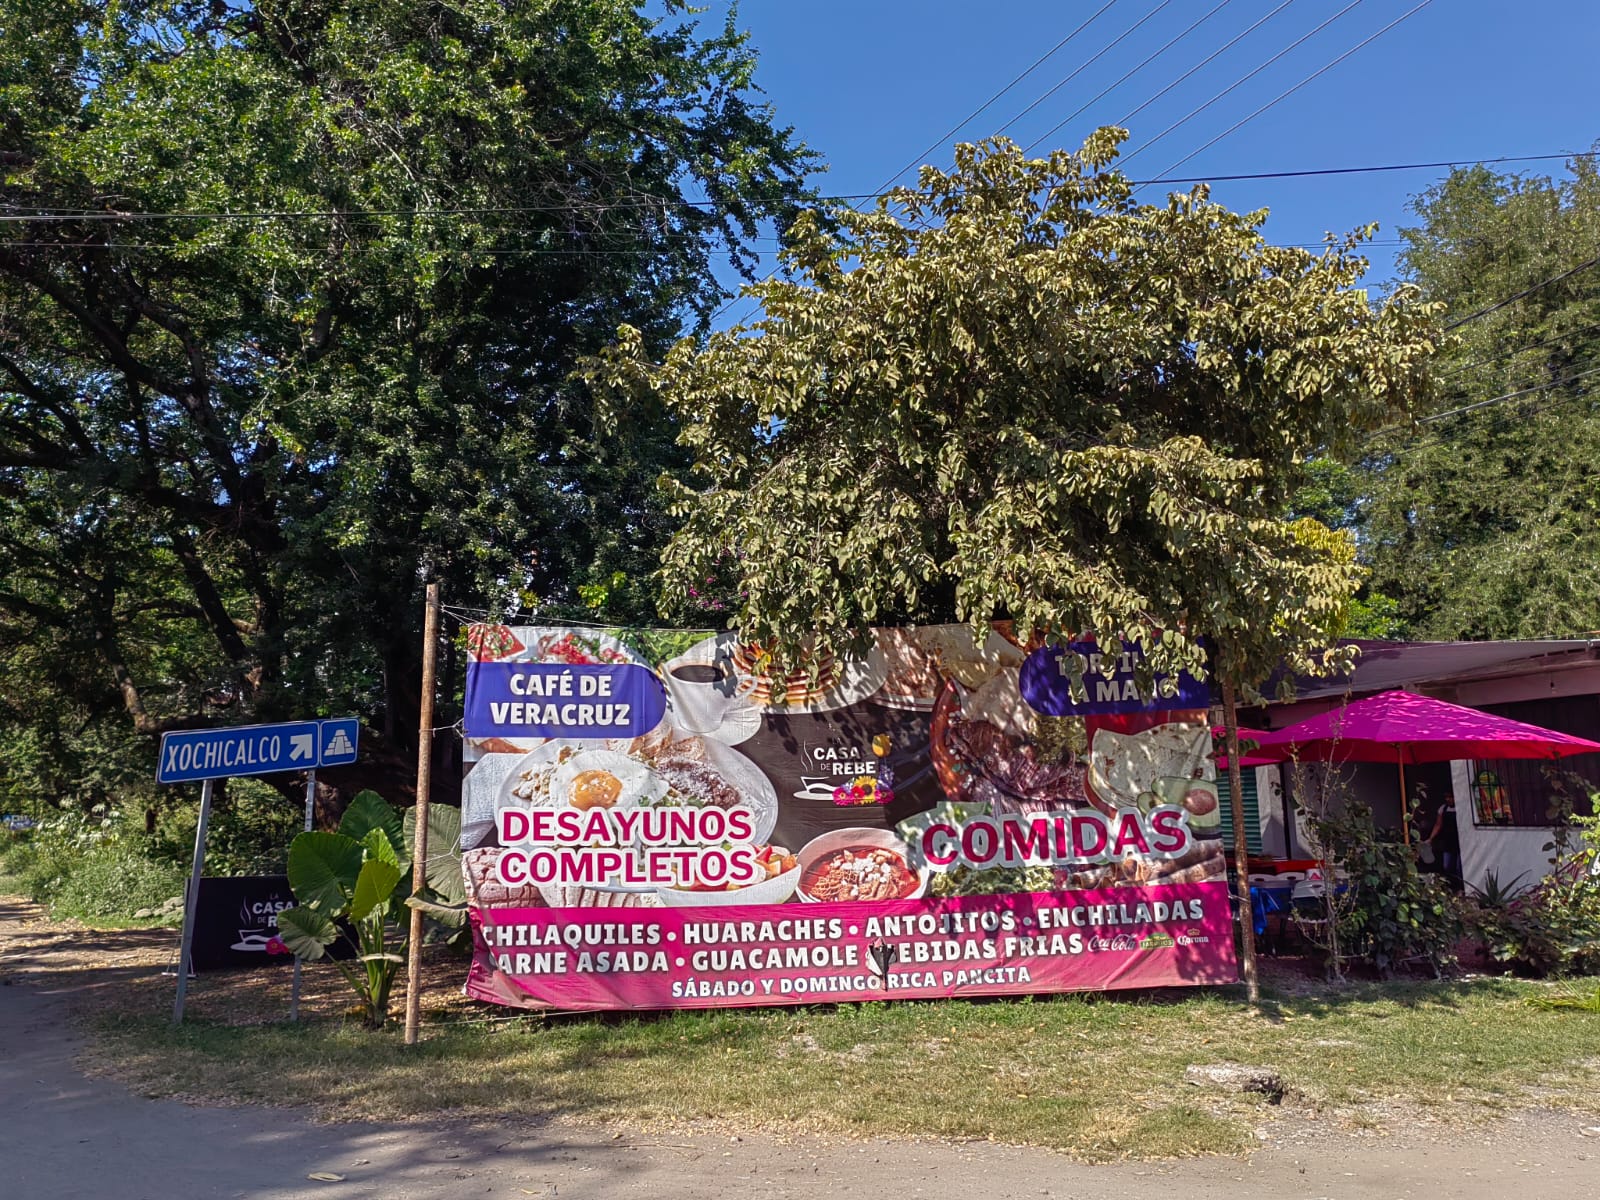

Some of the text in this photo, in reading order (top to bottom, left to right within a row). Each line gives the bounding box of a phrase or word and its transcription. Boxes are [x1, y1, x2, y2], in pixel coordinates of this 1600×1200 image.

[509, 669, 612, 698] CAFÉ DE
[1096, 677, 1177, 702] MAO
[490, 703, 630, 726] VERACRUZ
[165, 735, 280, 773] XOCHICALCO
[813, 746, 861, 760] CASA
[820, 761, 876, 776] DE REBE
[501, 808, 753, 843] DESAYUNOS
[920, 809, 1189, 867] COMIDAS
[499, 849, 755, 885] COMPLETOS
[252, 901, 294, 914] CASA
[257, 916, 266, 924] DE
[483, 899, 1204, 949] CHILAQUILES HUARACHES ANTOJITOS ENCHILADAS
[489, 933, 1083, 975] ARNE ASADA GUACAMOLE EBIDAS FRIAS
[671, 966, 1031, 998] SÁBADO Y DOMINGO RICA PANCITA
